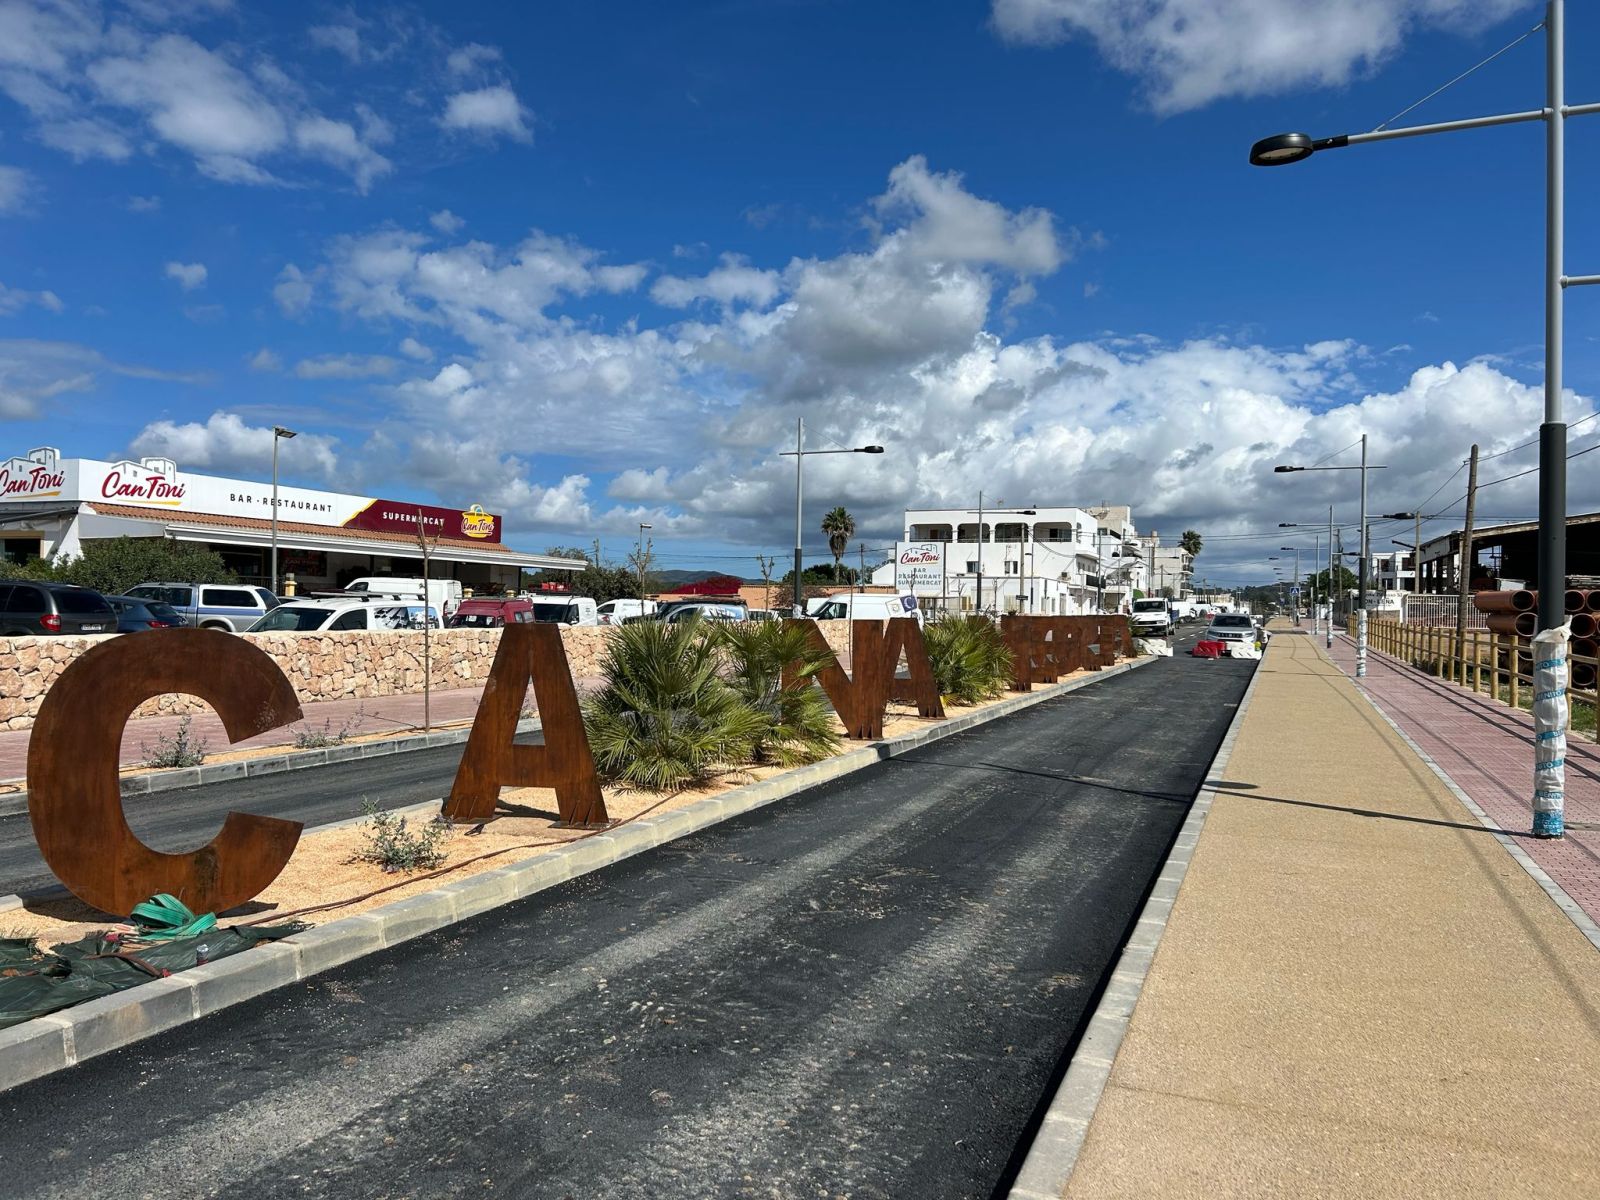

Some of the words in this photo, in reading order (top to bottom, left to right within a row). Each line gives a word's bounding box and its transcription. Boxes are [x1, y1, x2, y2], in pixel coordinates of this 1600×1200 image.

[230, 493, 252, 504] BAR
[263, 497, 332, 513] RESTAURANT
[382, 511, 445, 526] SUPERMRCAT
